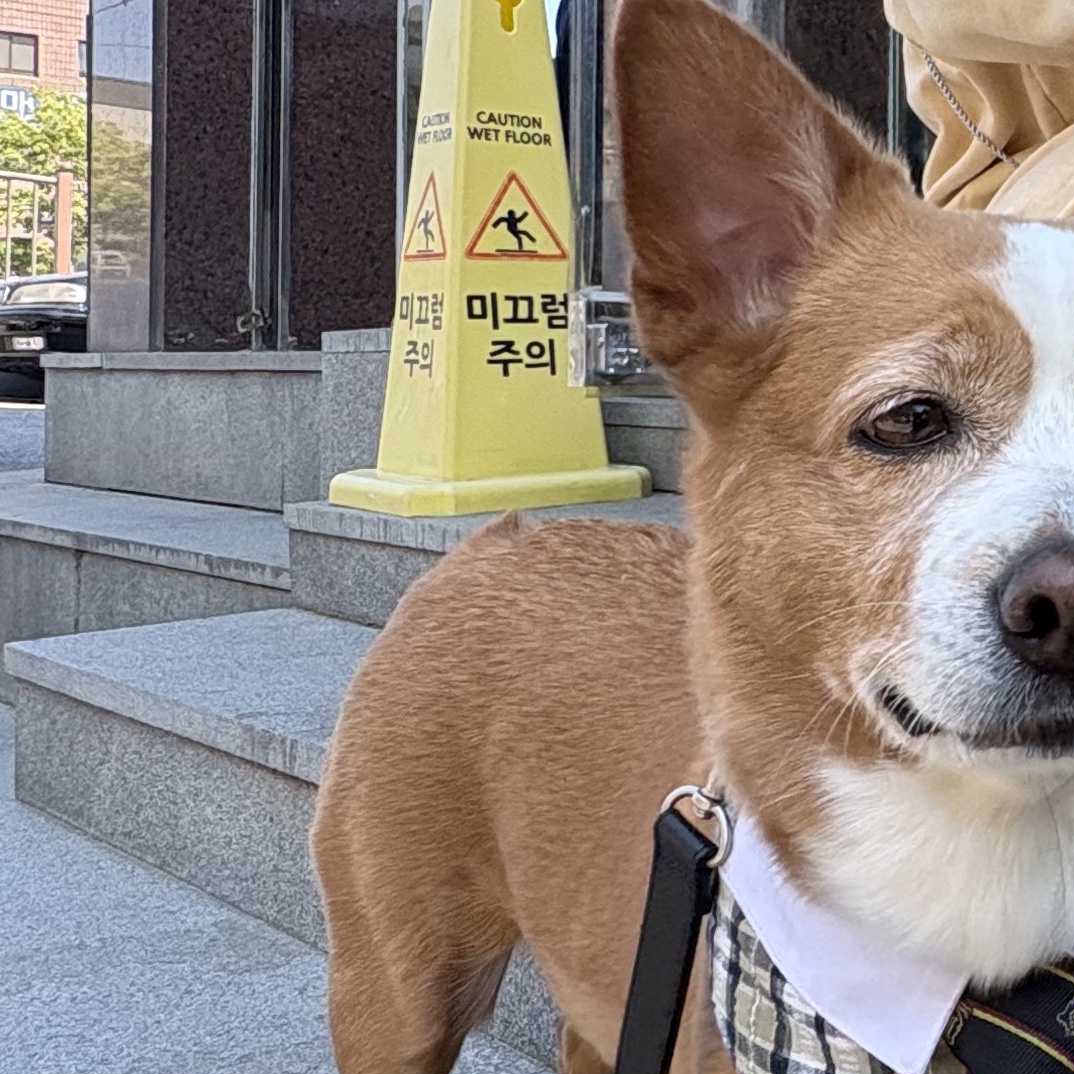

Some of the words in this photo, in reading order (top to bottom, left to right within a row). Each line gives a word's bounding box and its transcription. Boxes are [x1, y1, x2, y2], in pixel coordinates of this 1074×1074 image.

[421, 111, 451, 129] CAUTION
[476, 110, 543, 129] CAUTION
[417, 130, 432, 145] WET
[466, 125, 501, 142] WET
[504, 129, 552, 147] FLOOR
[399, 291, 445, 331] 미끄럼
[466, 291, 569, 331] 미끄럼
[403, 338, 435, 379] 주의
[486, 338, 557, 378] 주의
